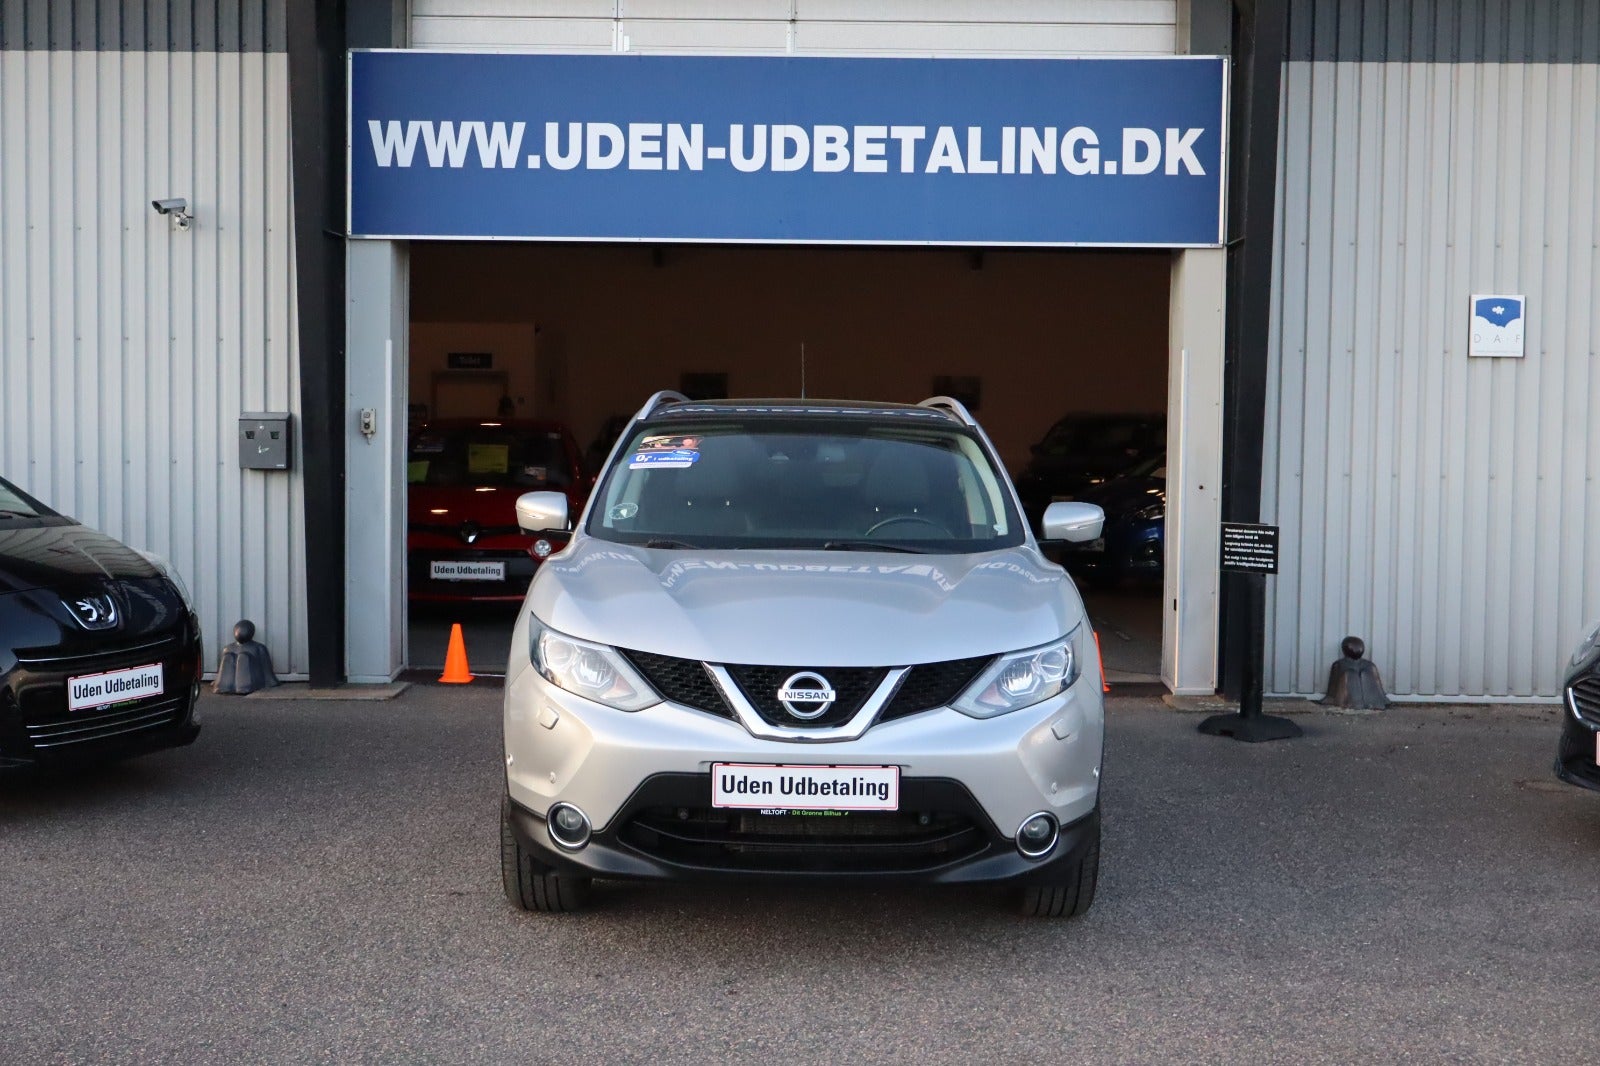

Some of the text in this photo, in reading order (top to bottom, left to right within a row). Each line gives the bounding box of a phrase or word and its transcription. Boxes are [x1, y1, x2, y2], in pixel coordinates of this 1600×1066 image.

[367, 119, 1207, 176] WWW.UDEN-UDBETALING.DK
[434, 565, 501, 576] Uden Udbetaling
[73, 673, 159, 700] Uden Udbetaling
[784, 691, 830, 700] NISSAN
[721, 774, 890, 801] Uden Udbetaling
